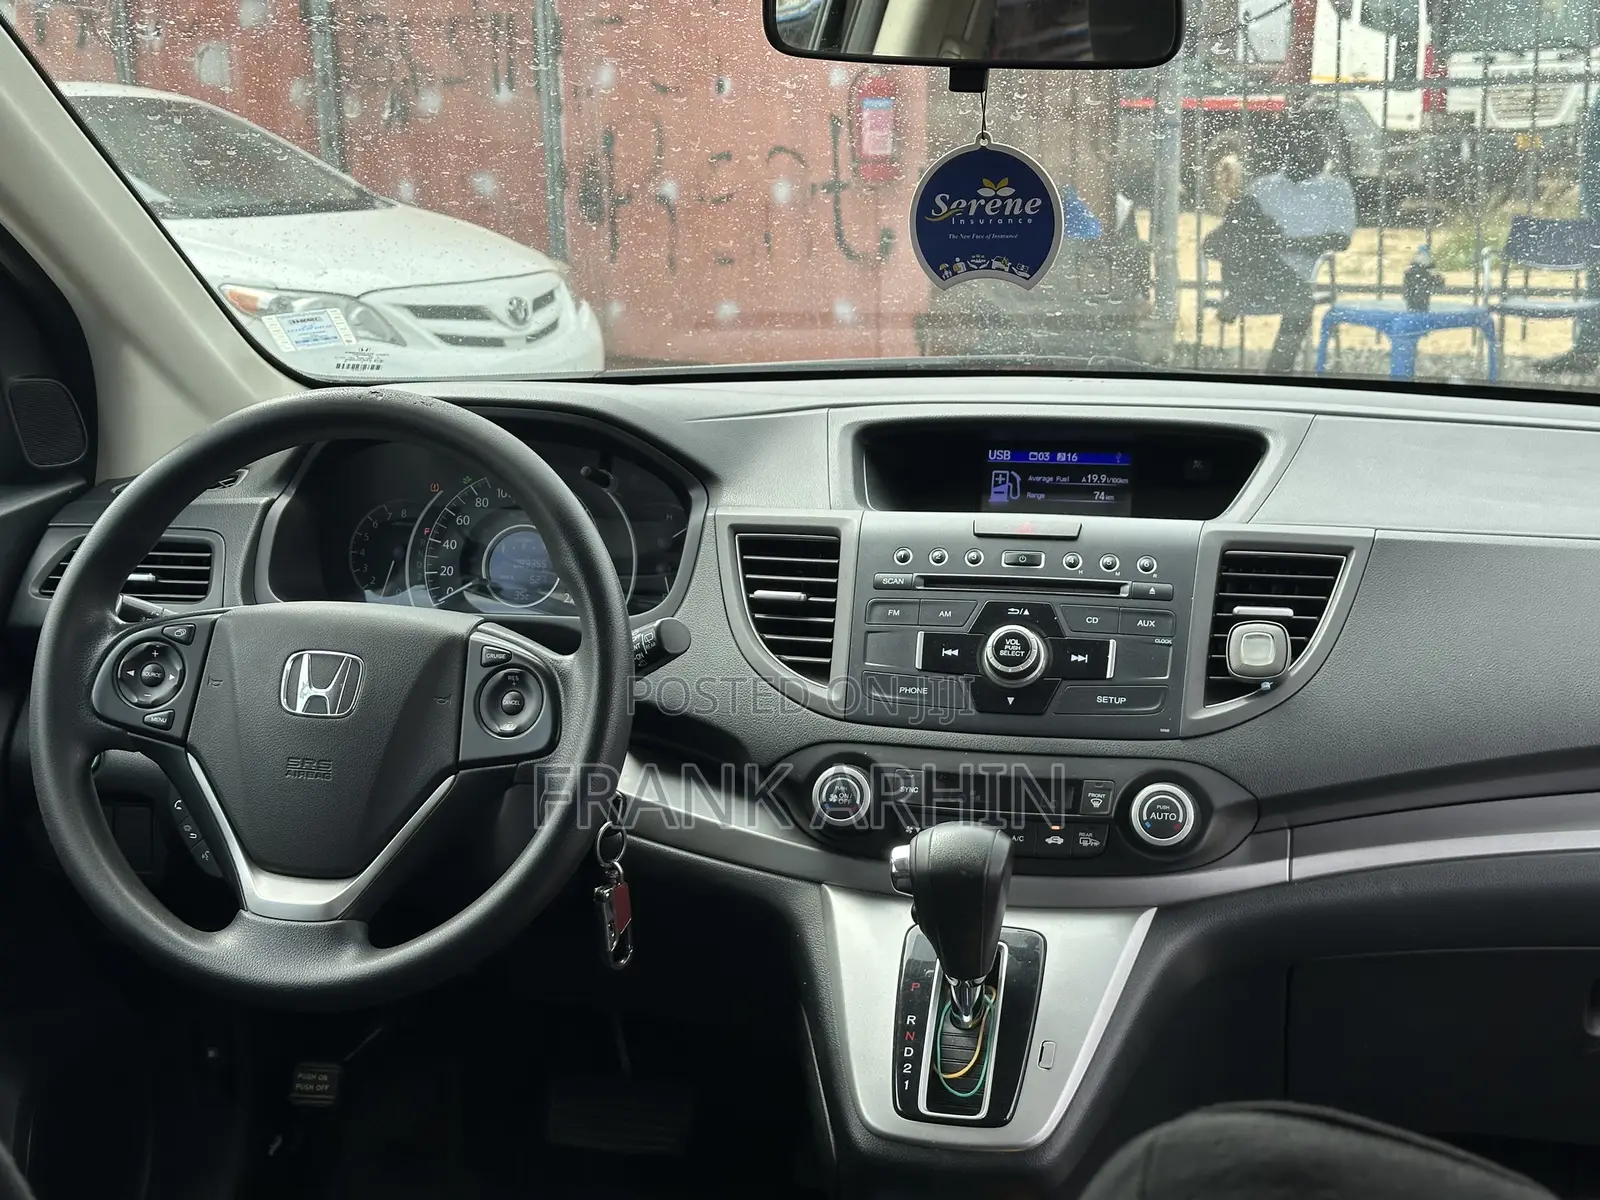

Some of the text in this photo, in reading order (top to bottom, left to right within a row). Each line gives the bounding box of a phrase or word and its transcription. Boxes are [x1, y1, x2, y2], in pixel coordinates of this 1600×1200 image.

[931, 193, 1042, 216] Serene
[988, 449, 1078, 462] USB 03 16
[1028, 475, 1053, 483] Average
[1056, 475, 1070, 483] Fuel
[496, 487, 512, 499] 10
[1026, 491, 1046, 500] Range
[475, 497, 489, 508] 80
[456, 515, 470, 526] 60
[442, 539, 457, 550] 40
[439, 565, 454, 577] 20
[882, 577, 905, 585] SCAN
[888, 609, 900, 617] FM
[938, 610, 952, 618] AM
[1086, 616, 1099, 625] CD
[1137, 619, 1156, 628] AUX
[1005, 638, 1021, 646] VOL
[999, 649, 1025, 658] SELECT
[899, 686, 928, 695] PHONE
[1096, 695, 1127, 705] SETUP
[151, 716, 168, 724] MENU
[286, 757, 334, 770] SRS
[285, 770, 333, 781] AIRBAG
[900, 786, 919, 794] SYNC
[1149, 811, 1177, 821] AUTO
[911, 982, 921, 991] P
[906, 1015, 917, 1025] R
[905, 1031, 915, 1041] N
[903, 1047, 914, 1057] D
[902, 1064, 912, 1074] 2
[904, 1080, 910, 1090] 1
